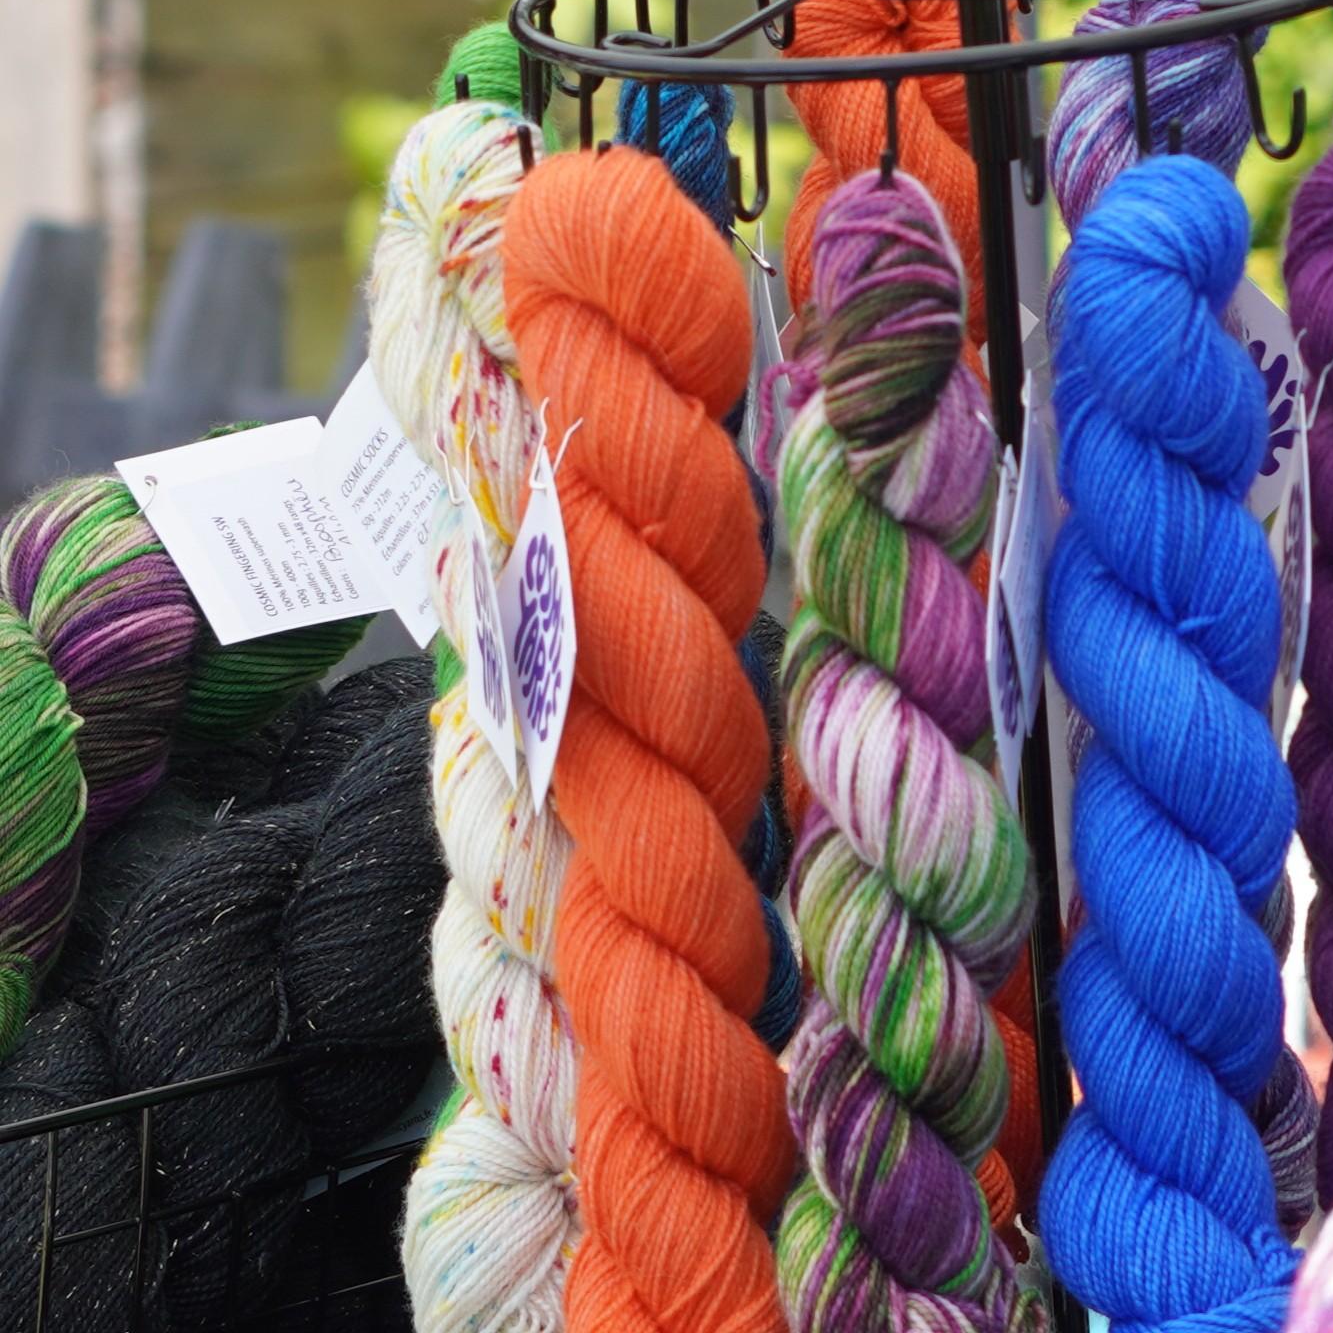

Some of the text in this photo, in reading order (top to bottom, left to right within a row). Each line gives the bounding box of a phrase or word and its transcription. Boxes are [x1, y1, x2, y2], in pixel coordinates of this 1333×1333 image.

[341, 427, 389, 498] COSMIC SOCKS
[383, 437, 408, 469] superwa
[237, 517, 265, 557] superwash
[211, 516, 278, 617] COSMIC FINGERING SW
[281, 560, 297, 583] 400m
[297, 589, 311, 608] 100g
[306, 572, 328, 604] Aiguilles
[342, 573, 359, 599] Coloris
[514, 577, 550, 742] YARNS
